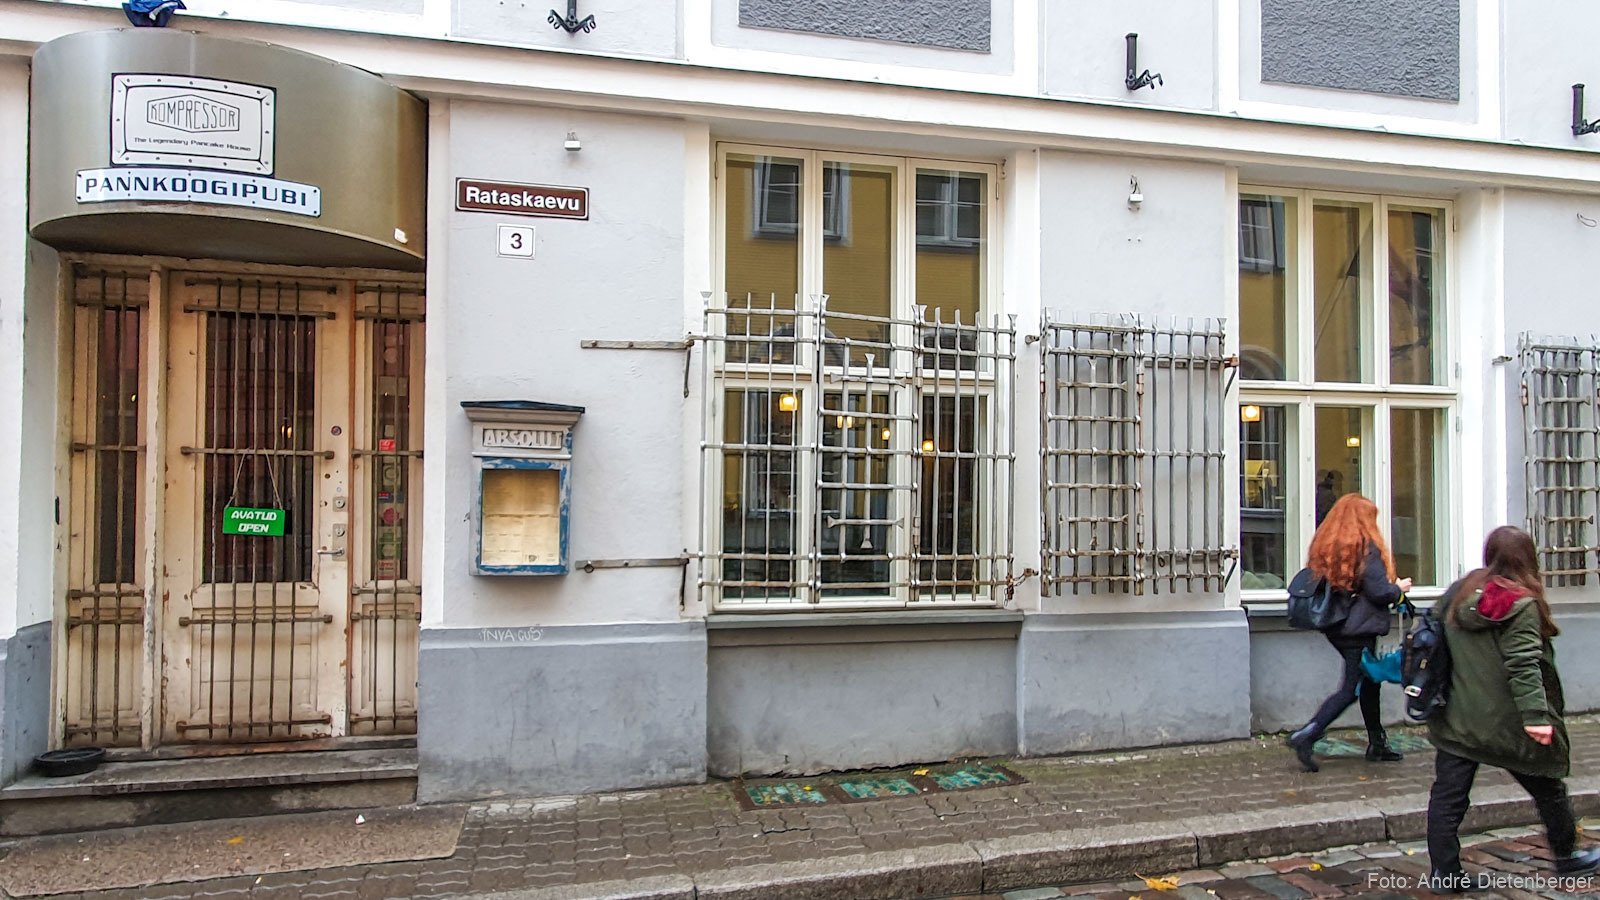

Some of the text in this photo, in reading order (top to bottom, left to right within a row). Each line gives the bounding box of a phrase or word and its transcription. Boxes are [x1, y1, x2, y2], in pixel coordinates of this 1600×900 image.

[150, 99, 237, 130] KOMPRESSOR
[149, 137, 189, 146] Legendary
[190, 140, 225, 149] Pancake
[226, 143, 252, 152] House
[85, 177, 307, 207] PANNKOOGIPUBI
[465, 186, 580, 211] Rataskaevu
[510, 232, 523, 250] 3
[484, 429, 563, 448] ABSOLUT
[231, 510, 277, 521] AVATUD
[238, 523, 269, 533] OPEN
